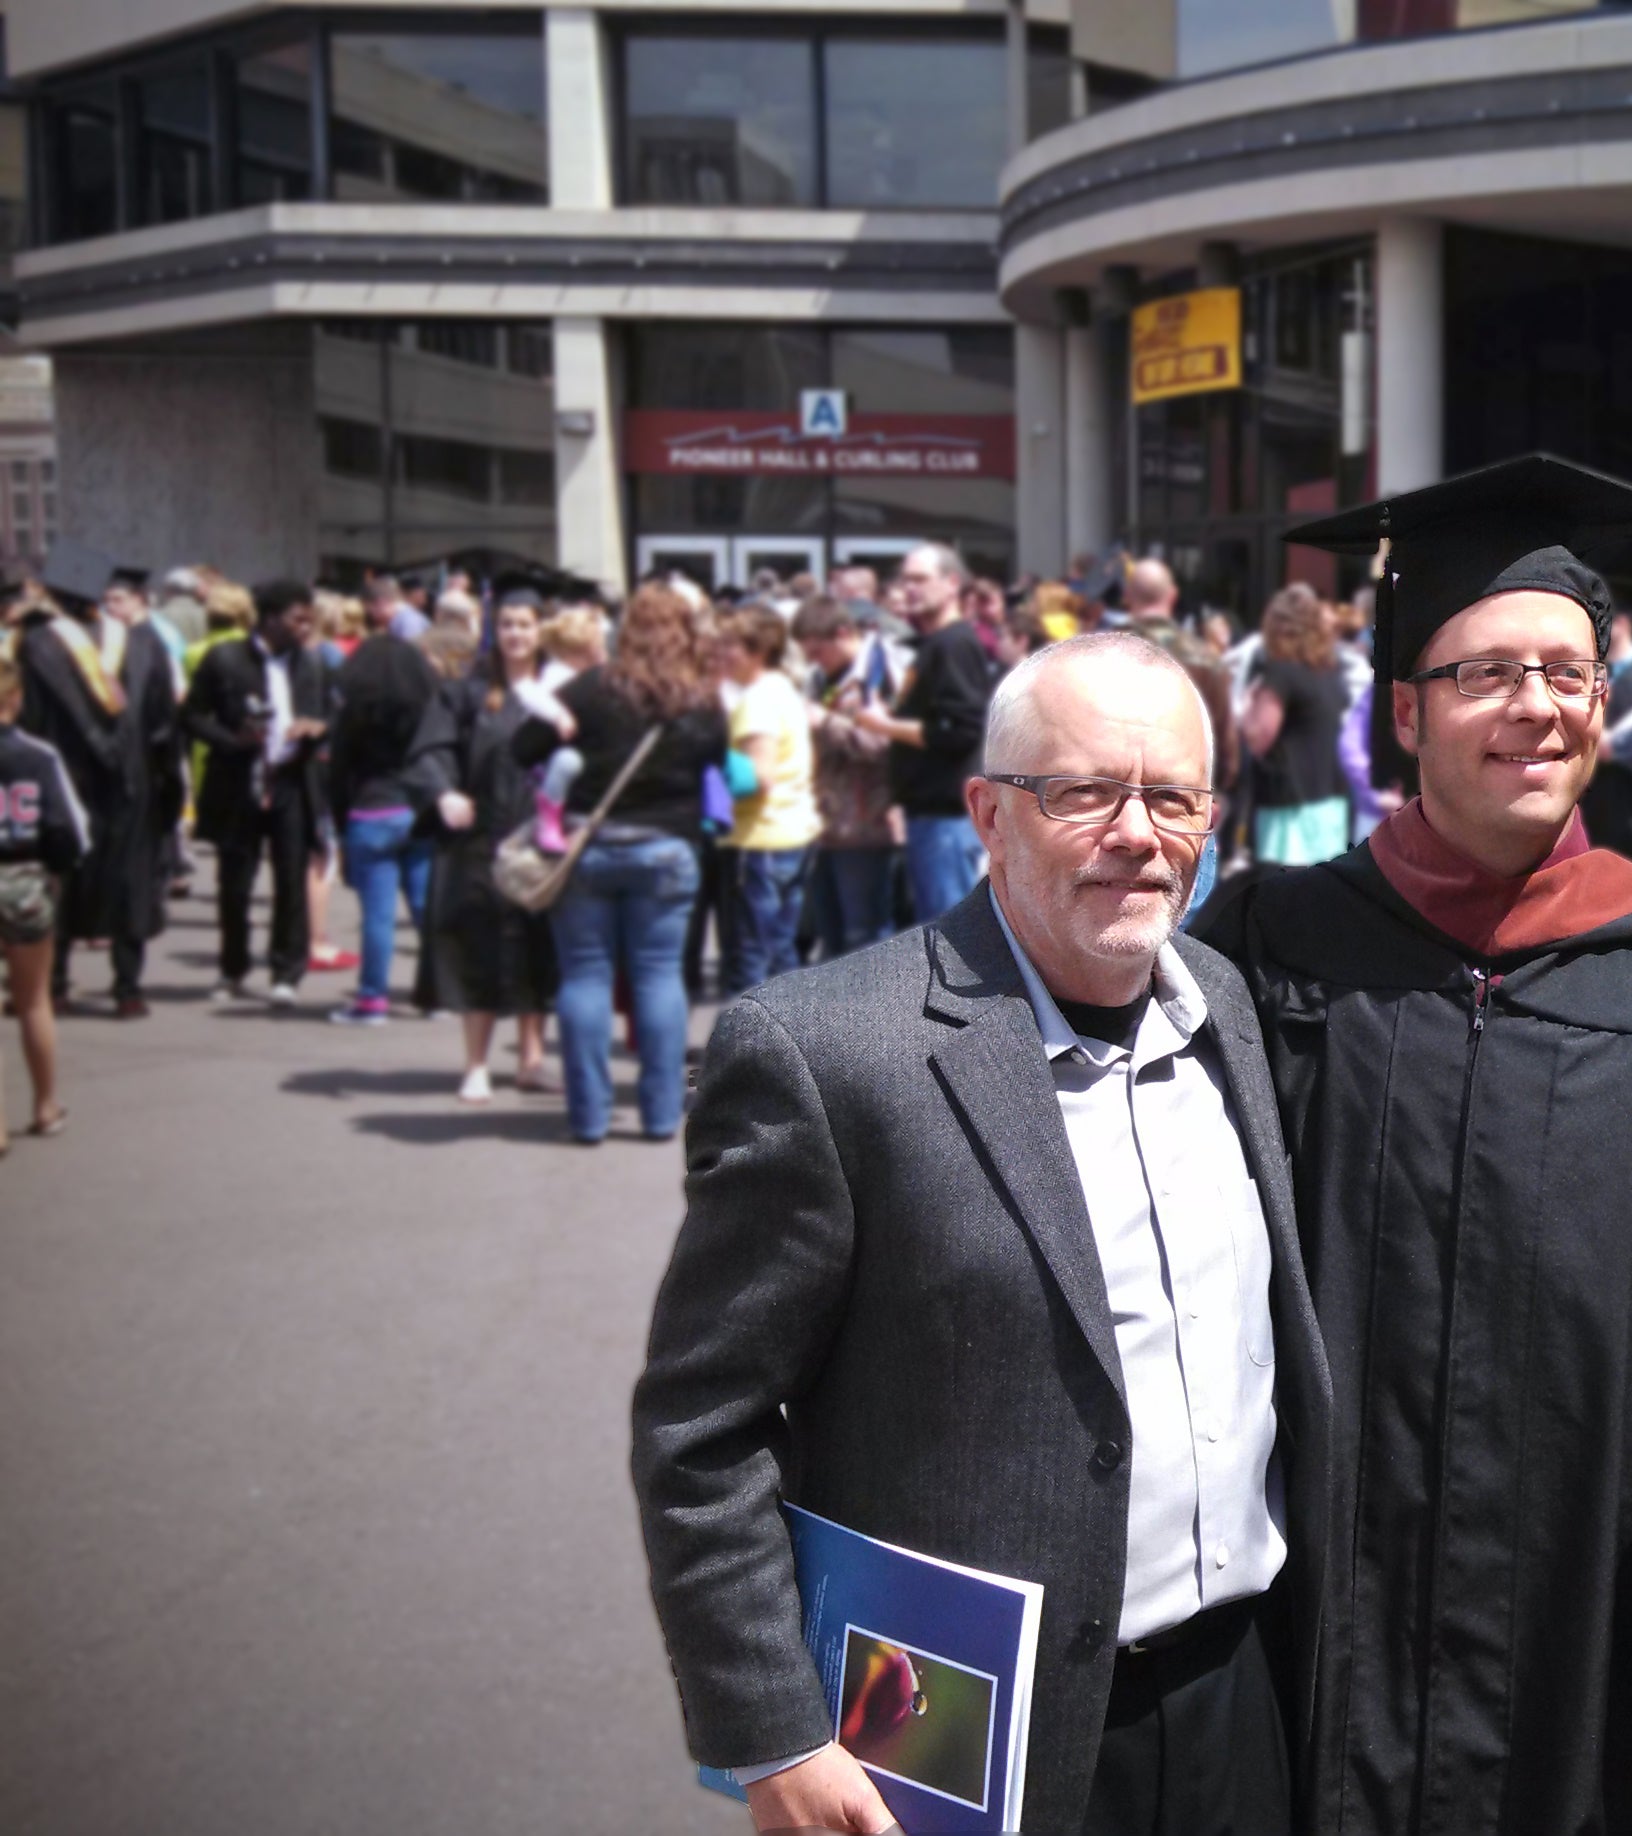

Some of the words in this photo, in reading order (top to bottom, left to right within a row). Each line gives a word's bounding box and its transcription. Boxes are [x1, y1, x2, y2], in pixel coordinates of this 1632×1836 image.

[809, 394, 839, 429] A
[669, 447, 753, 468] PIONEER
[758, 448, 808, 469] HALL
[814, 449, 829, 470] &
[833, 449, 921, 471] CURLING
[926, 450, 979, 472] CLUB
[0, 780, 40, 823] C
